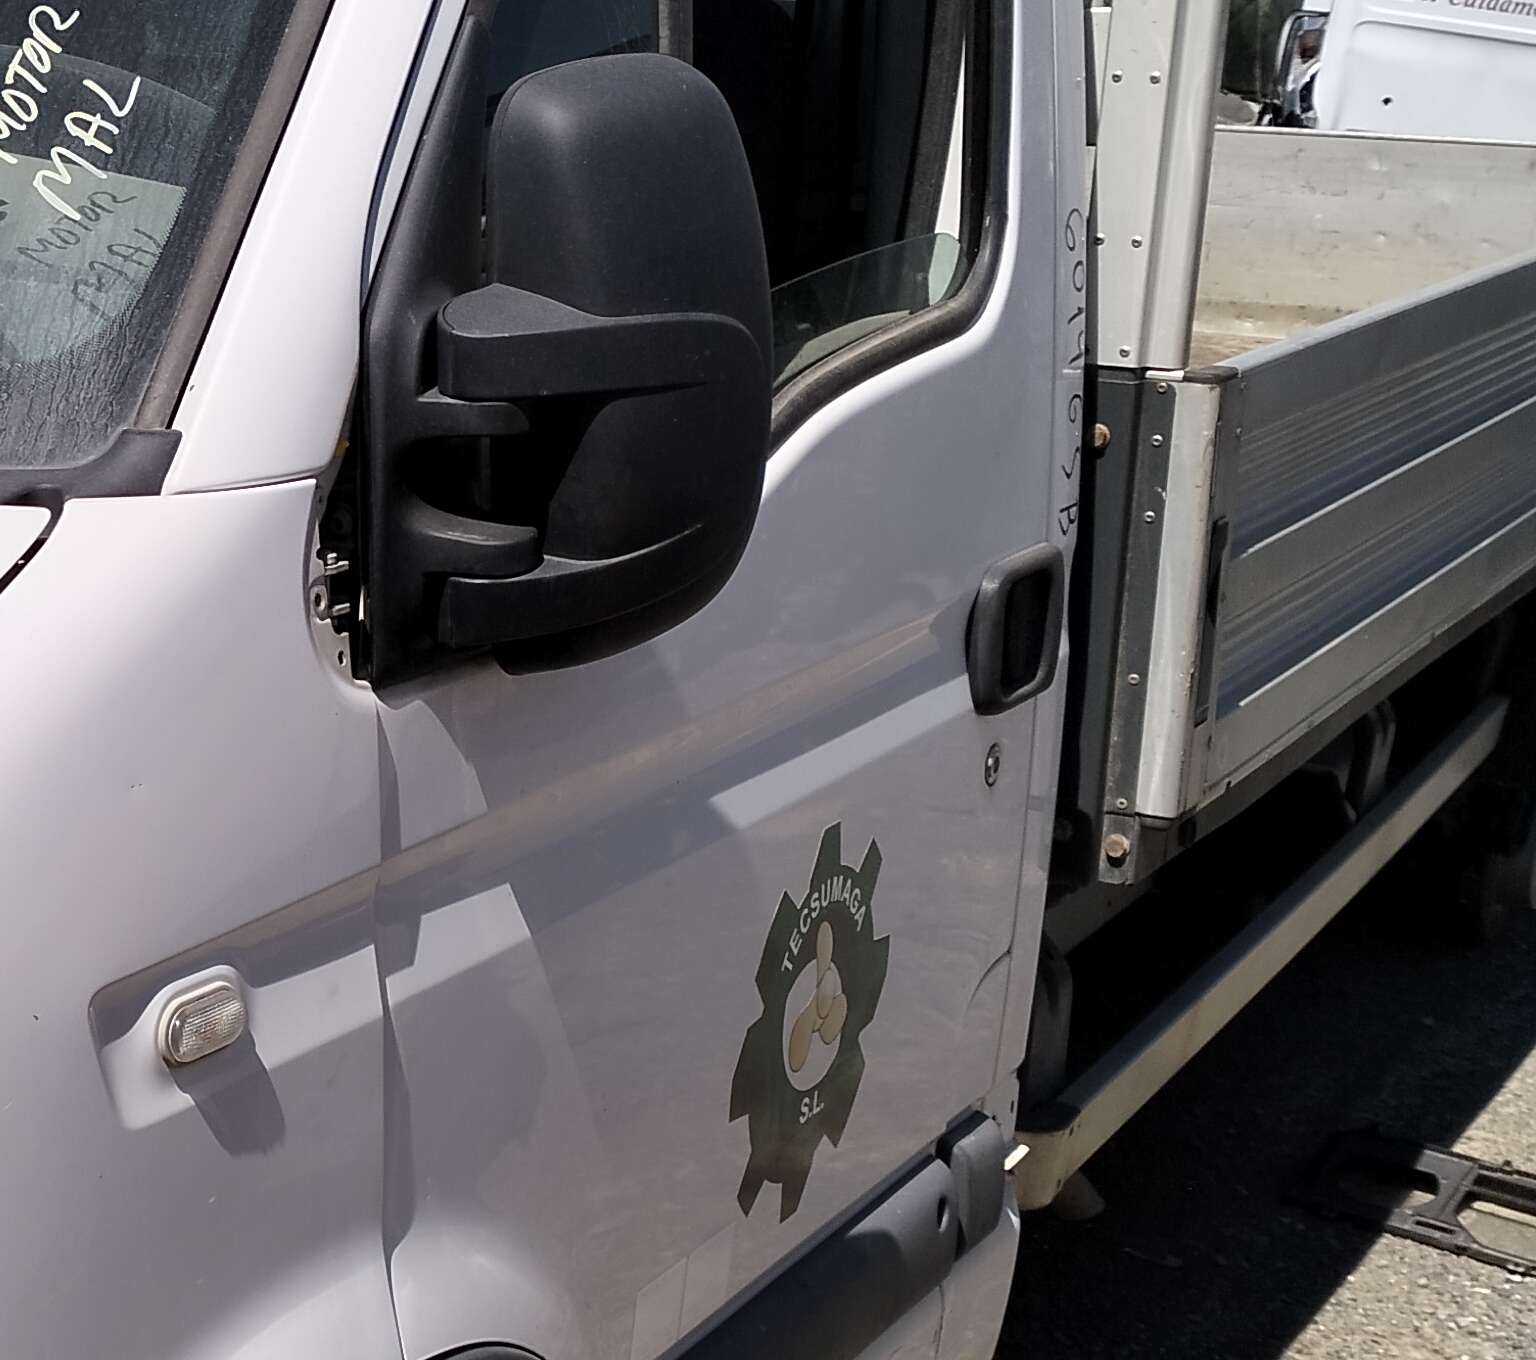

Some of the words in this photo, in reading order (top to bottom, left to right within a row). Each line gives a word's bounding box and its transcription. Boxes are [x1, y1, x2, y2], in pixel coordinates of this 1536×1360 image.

[32, 75, 141, 221] MAL
[780, 874, 867, 973] TECSUMAGA
[798, 1089, 825, 1124] S.L.
